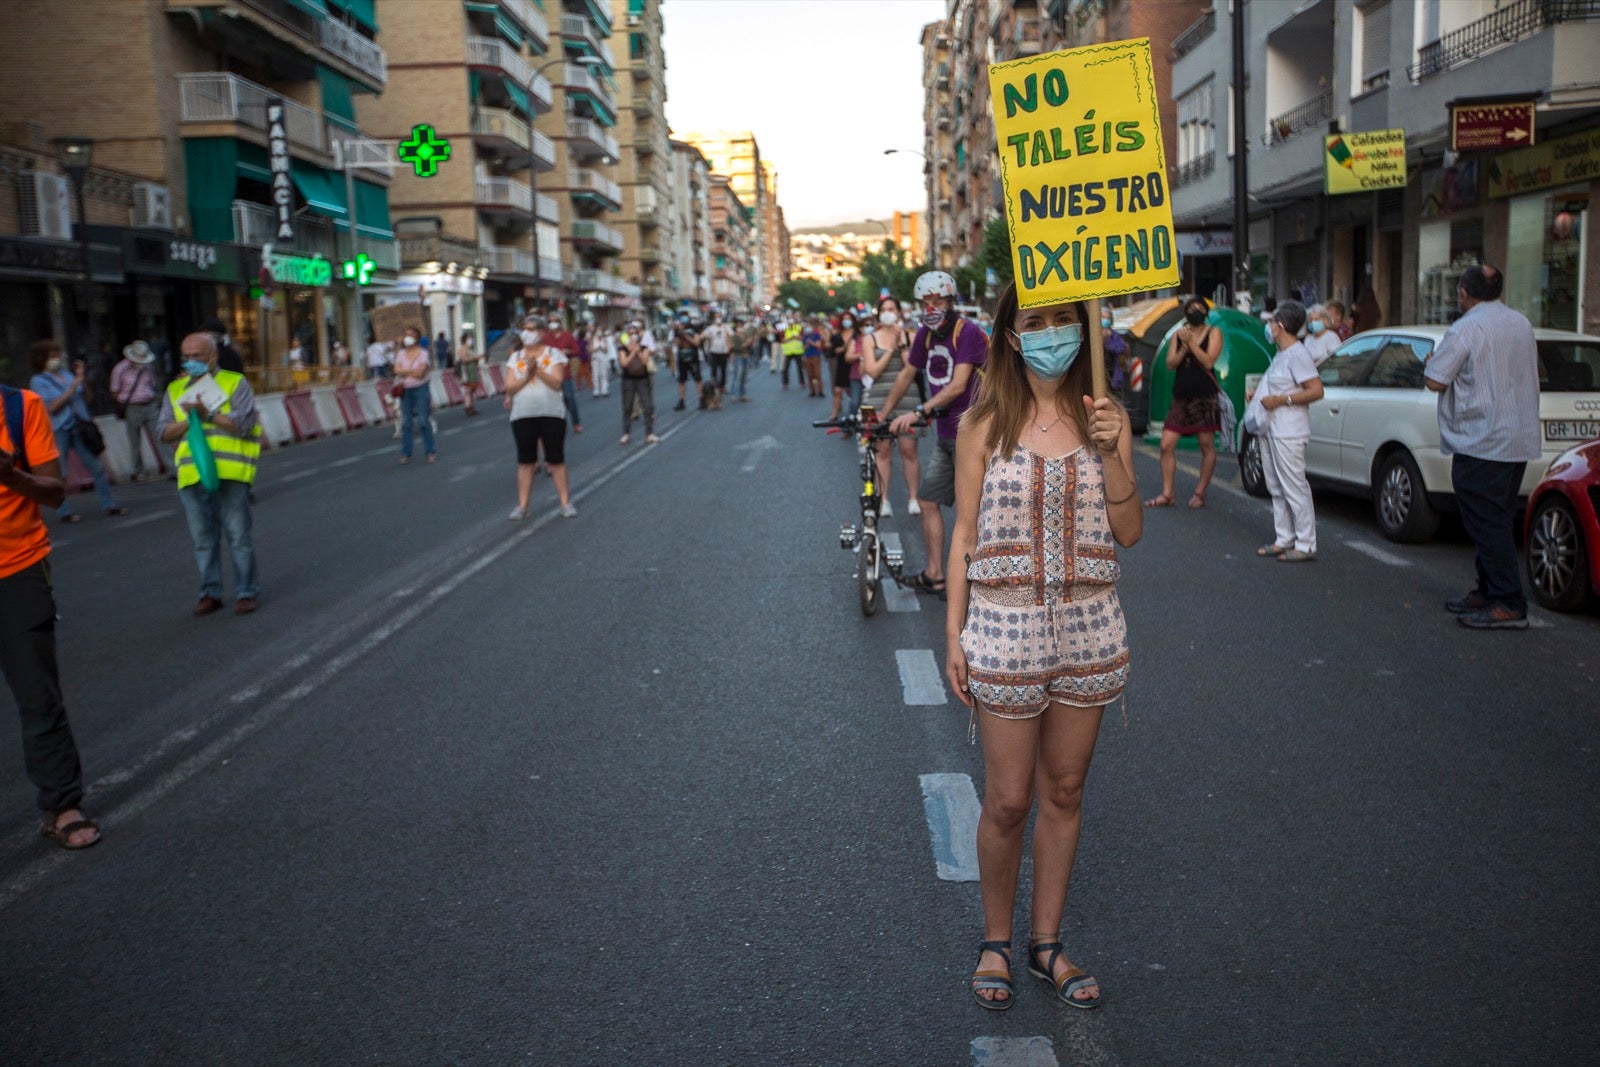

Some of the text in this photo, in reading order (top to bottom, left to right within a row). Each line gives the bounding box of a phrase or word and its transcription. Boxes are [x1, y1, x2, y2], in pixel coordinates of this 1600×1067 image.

[1003, 68, 1070, 118] NO
[1008, 109, 1145, 168] TALÉIS
[1351, 130, 1402, 147] Calzados
[267, 104, 294, 238] FARMACIA
[1360, 174, 1405, 188] Cadete
[1020, 172, 1164, 222] NUESTRO
[1018, 225, 1172, 290] OXÍGENO
[1549, 421, 1600, 437] GR-104
